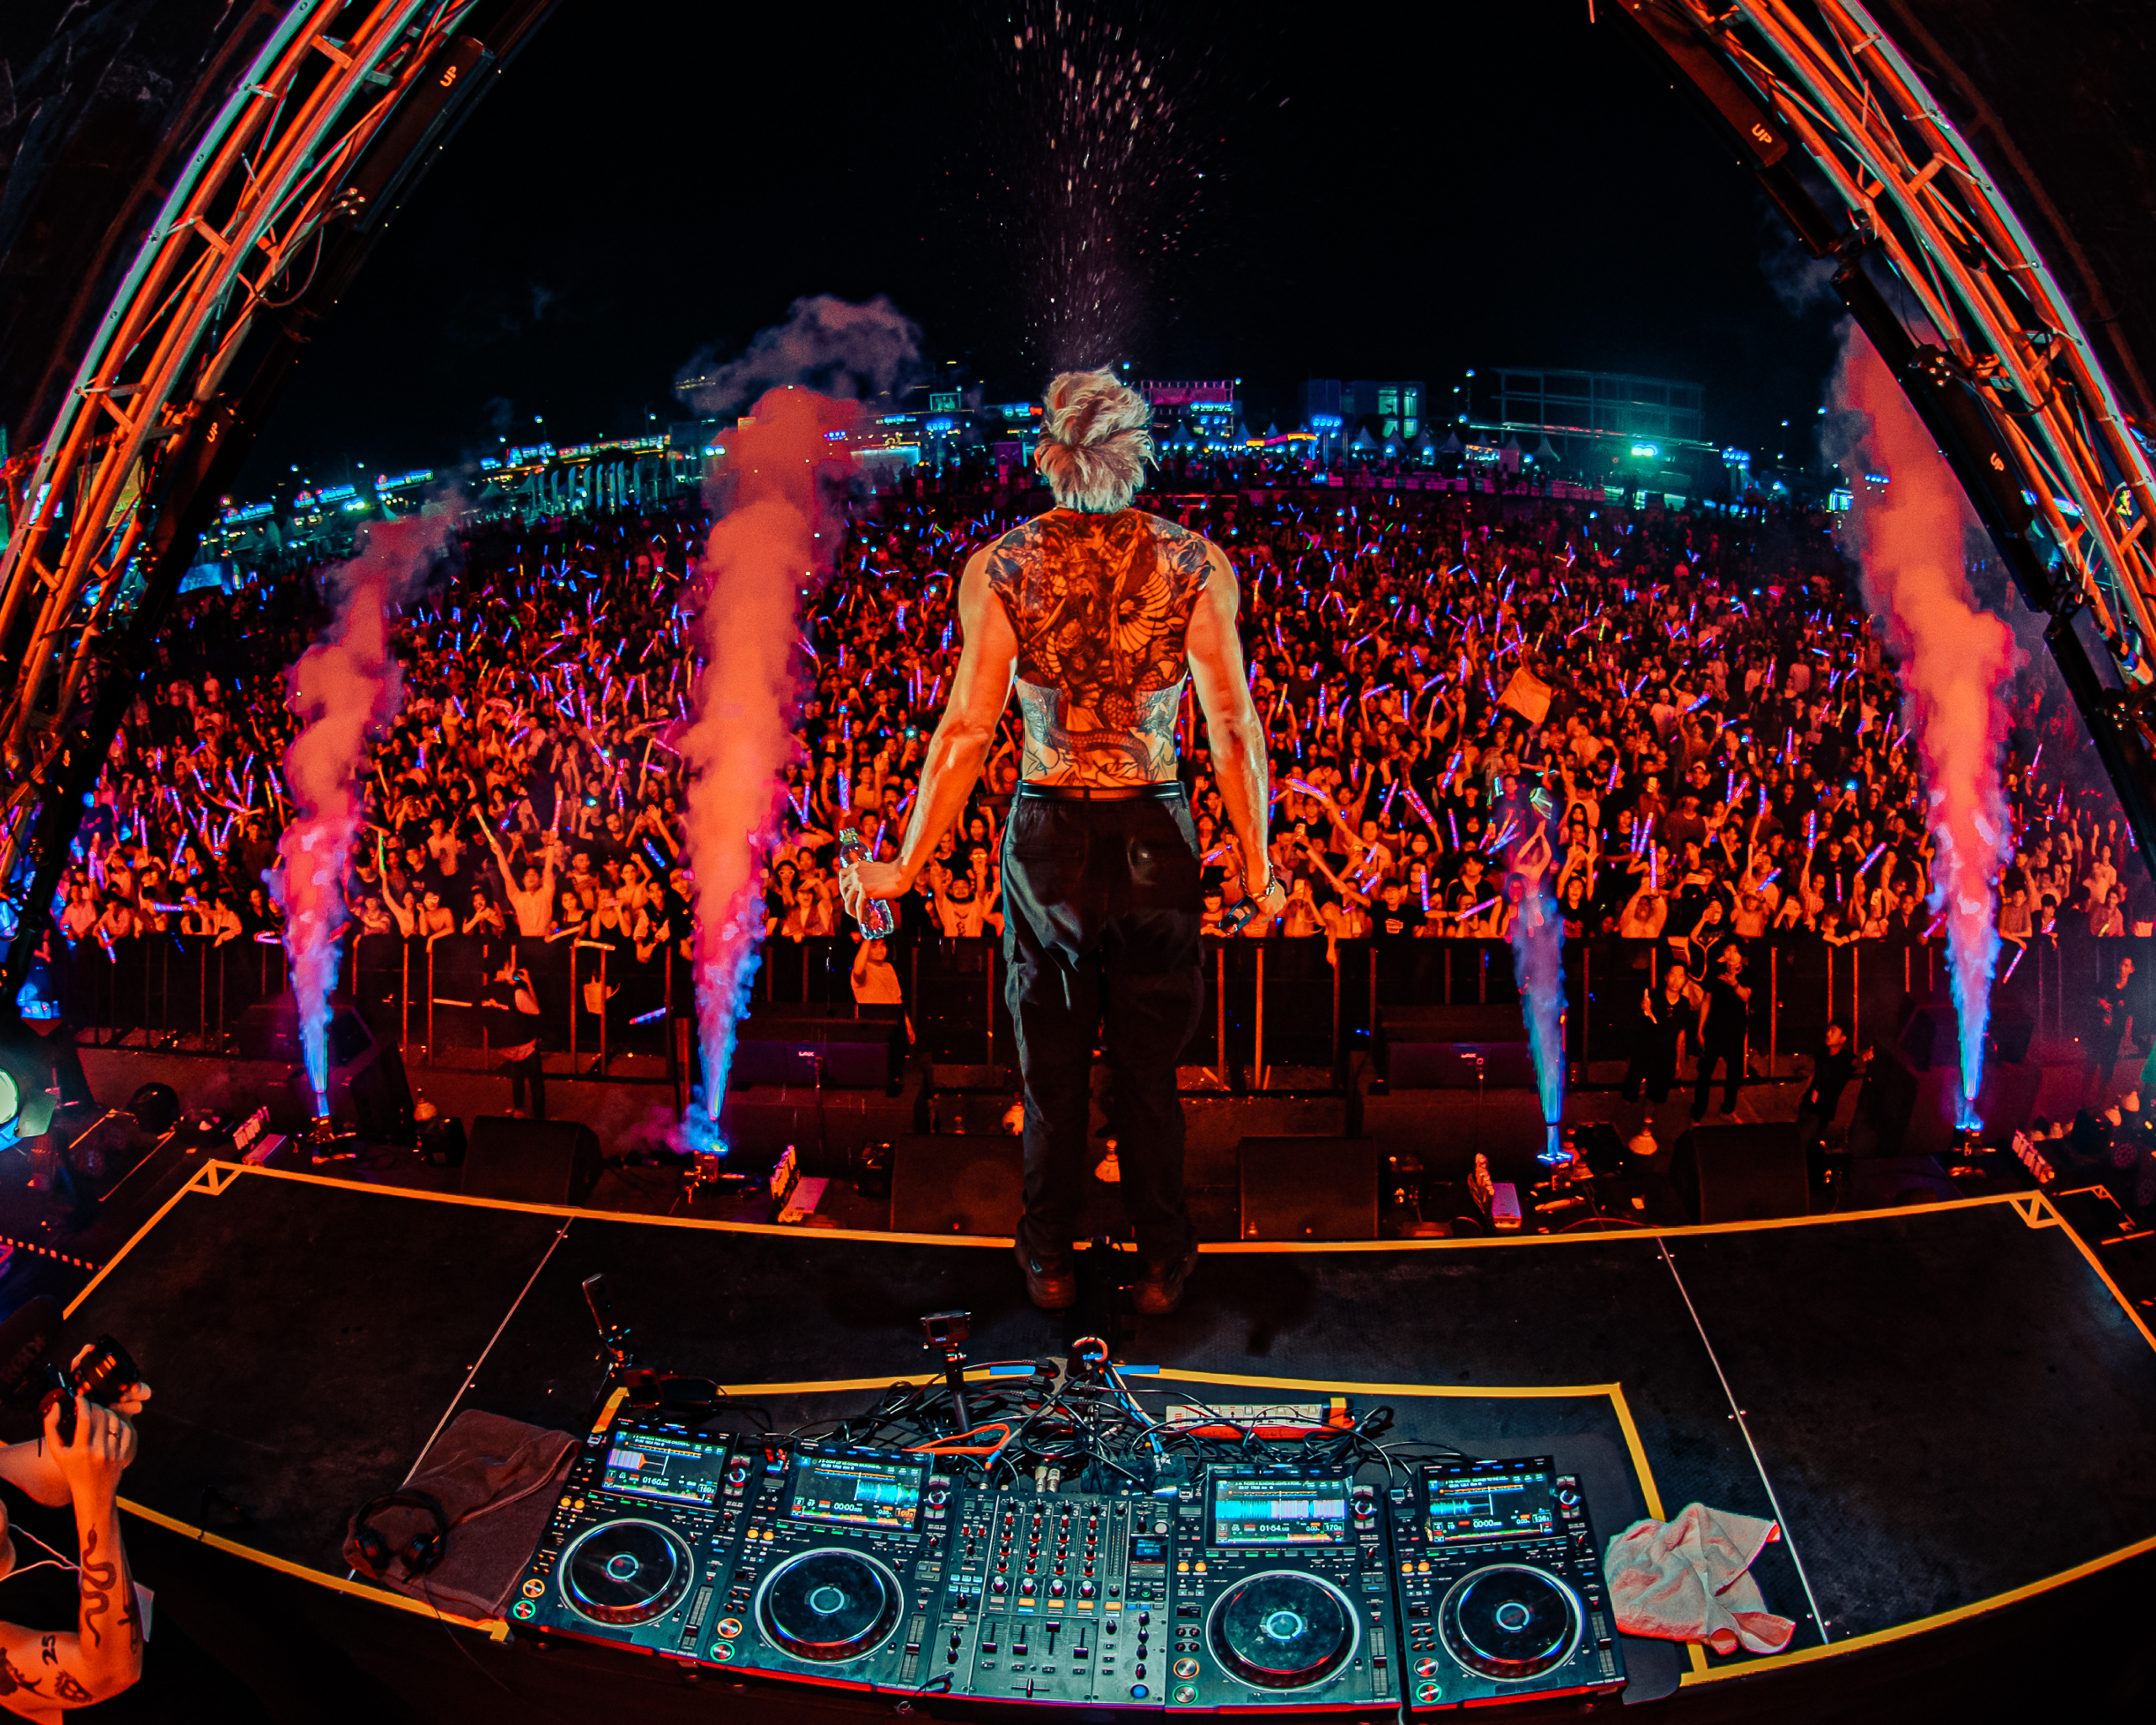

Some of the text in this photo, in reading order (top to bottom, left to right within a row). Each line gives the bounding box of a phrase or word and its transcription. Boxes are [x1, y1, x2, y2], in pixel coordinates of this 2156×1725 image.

[440, 66, 456, 87] UP
[1752, 123, 1773, 143] UP
[206, 422, 218, 442] UP
[1990, 451, 2004, 471] UP
[41, 1635, 59, 1666] 25
